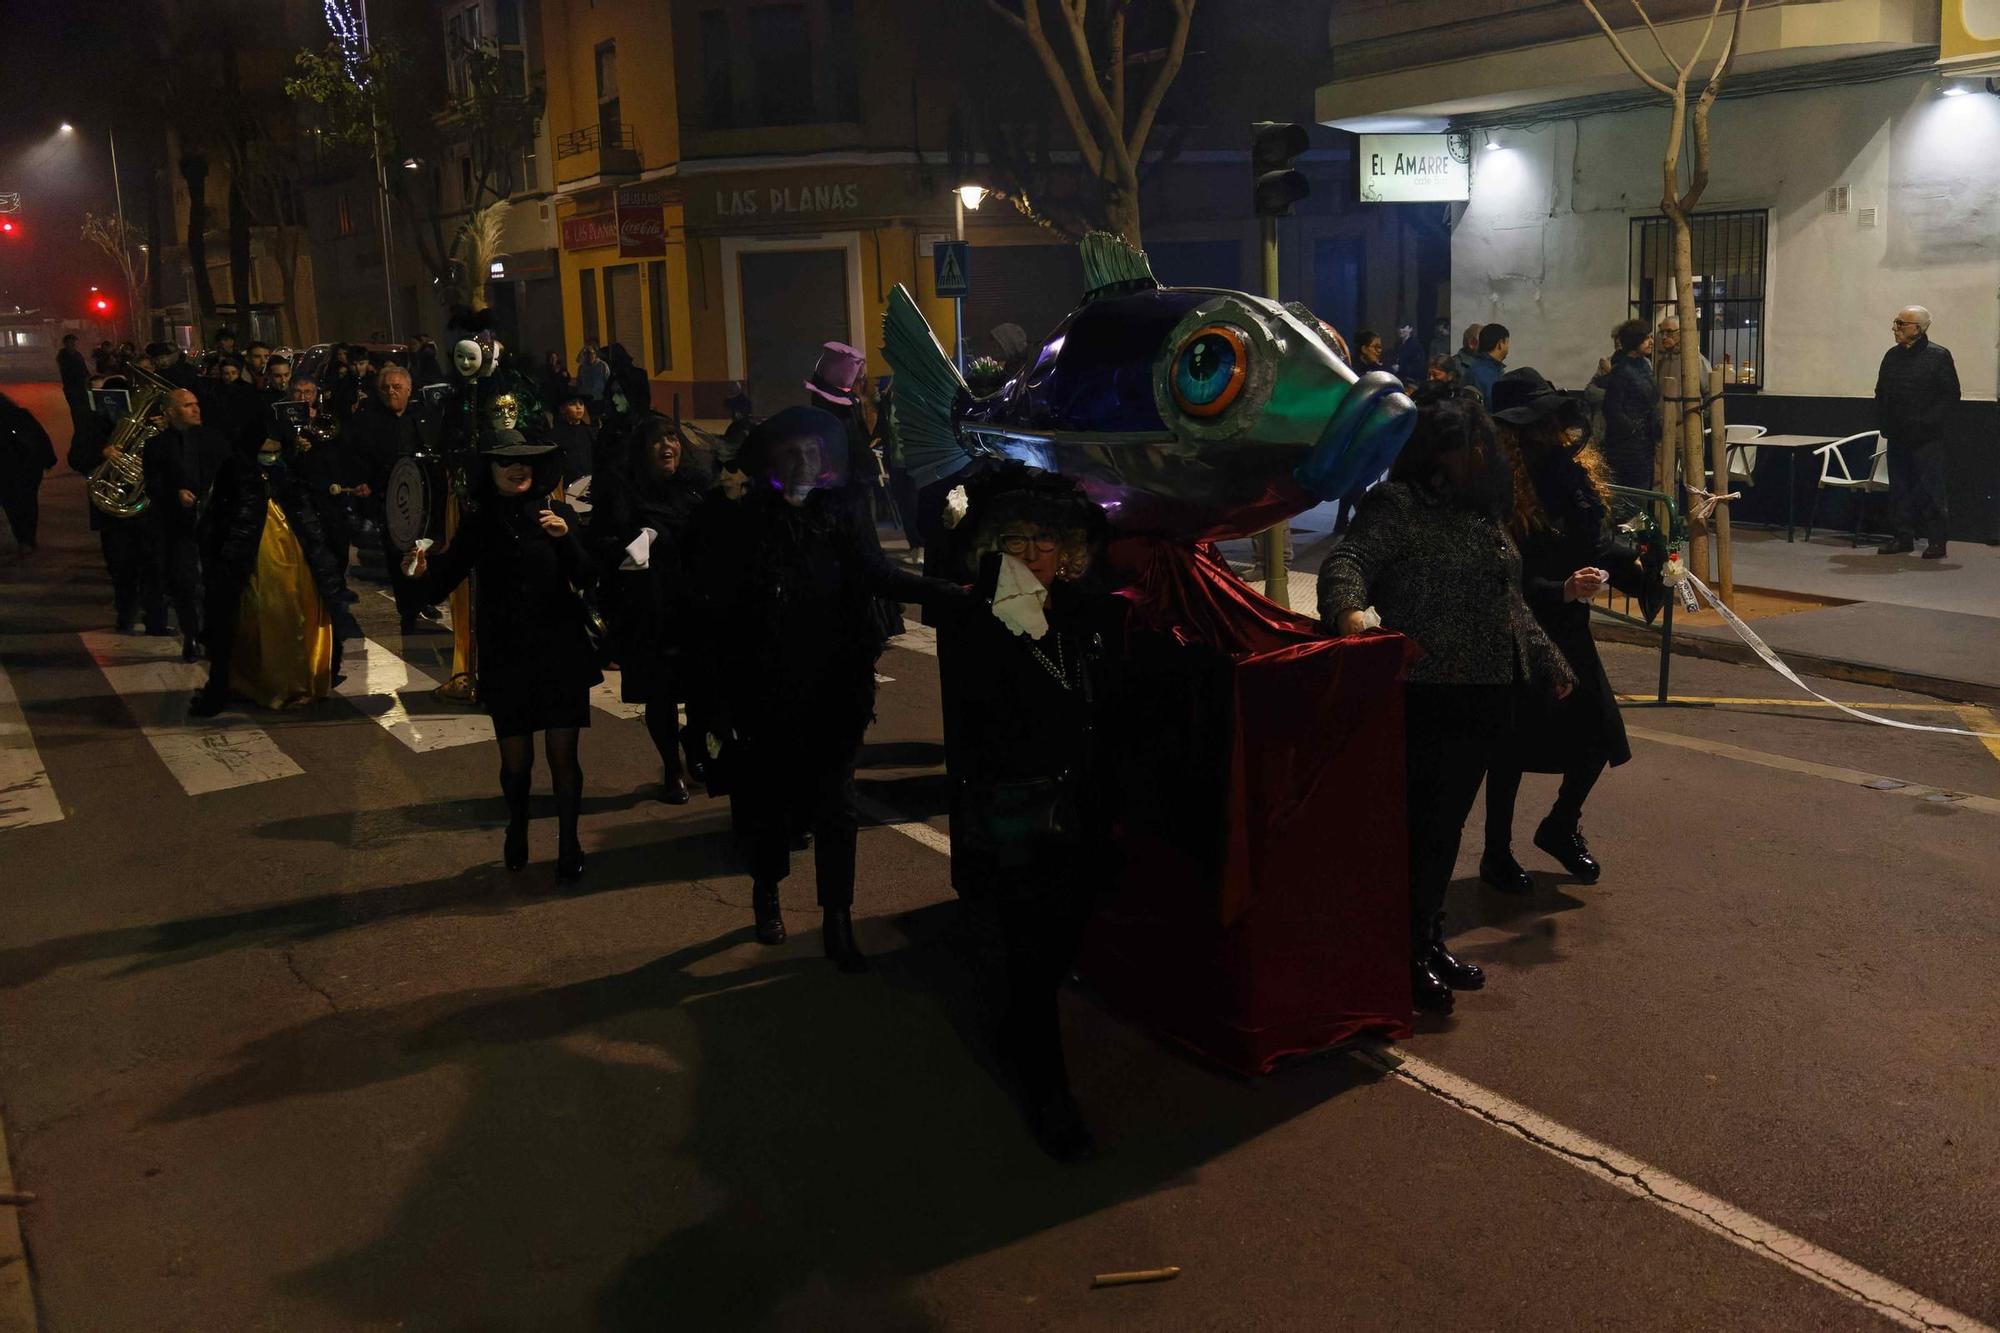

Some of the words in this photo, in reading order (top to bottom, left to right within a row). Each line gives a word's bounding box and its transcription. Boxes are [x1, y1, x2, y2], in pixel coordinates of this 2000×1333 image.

[1372, 154, 1386, 176] EL
[1395, 153, 1448, 175] AMARRE
[716, 189, 759, 217] LAS
[769, 184, 858, 214] PLANAS
